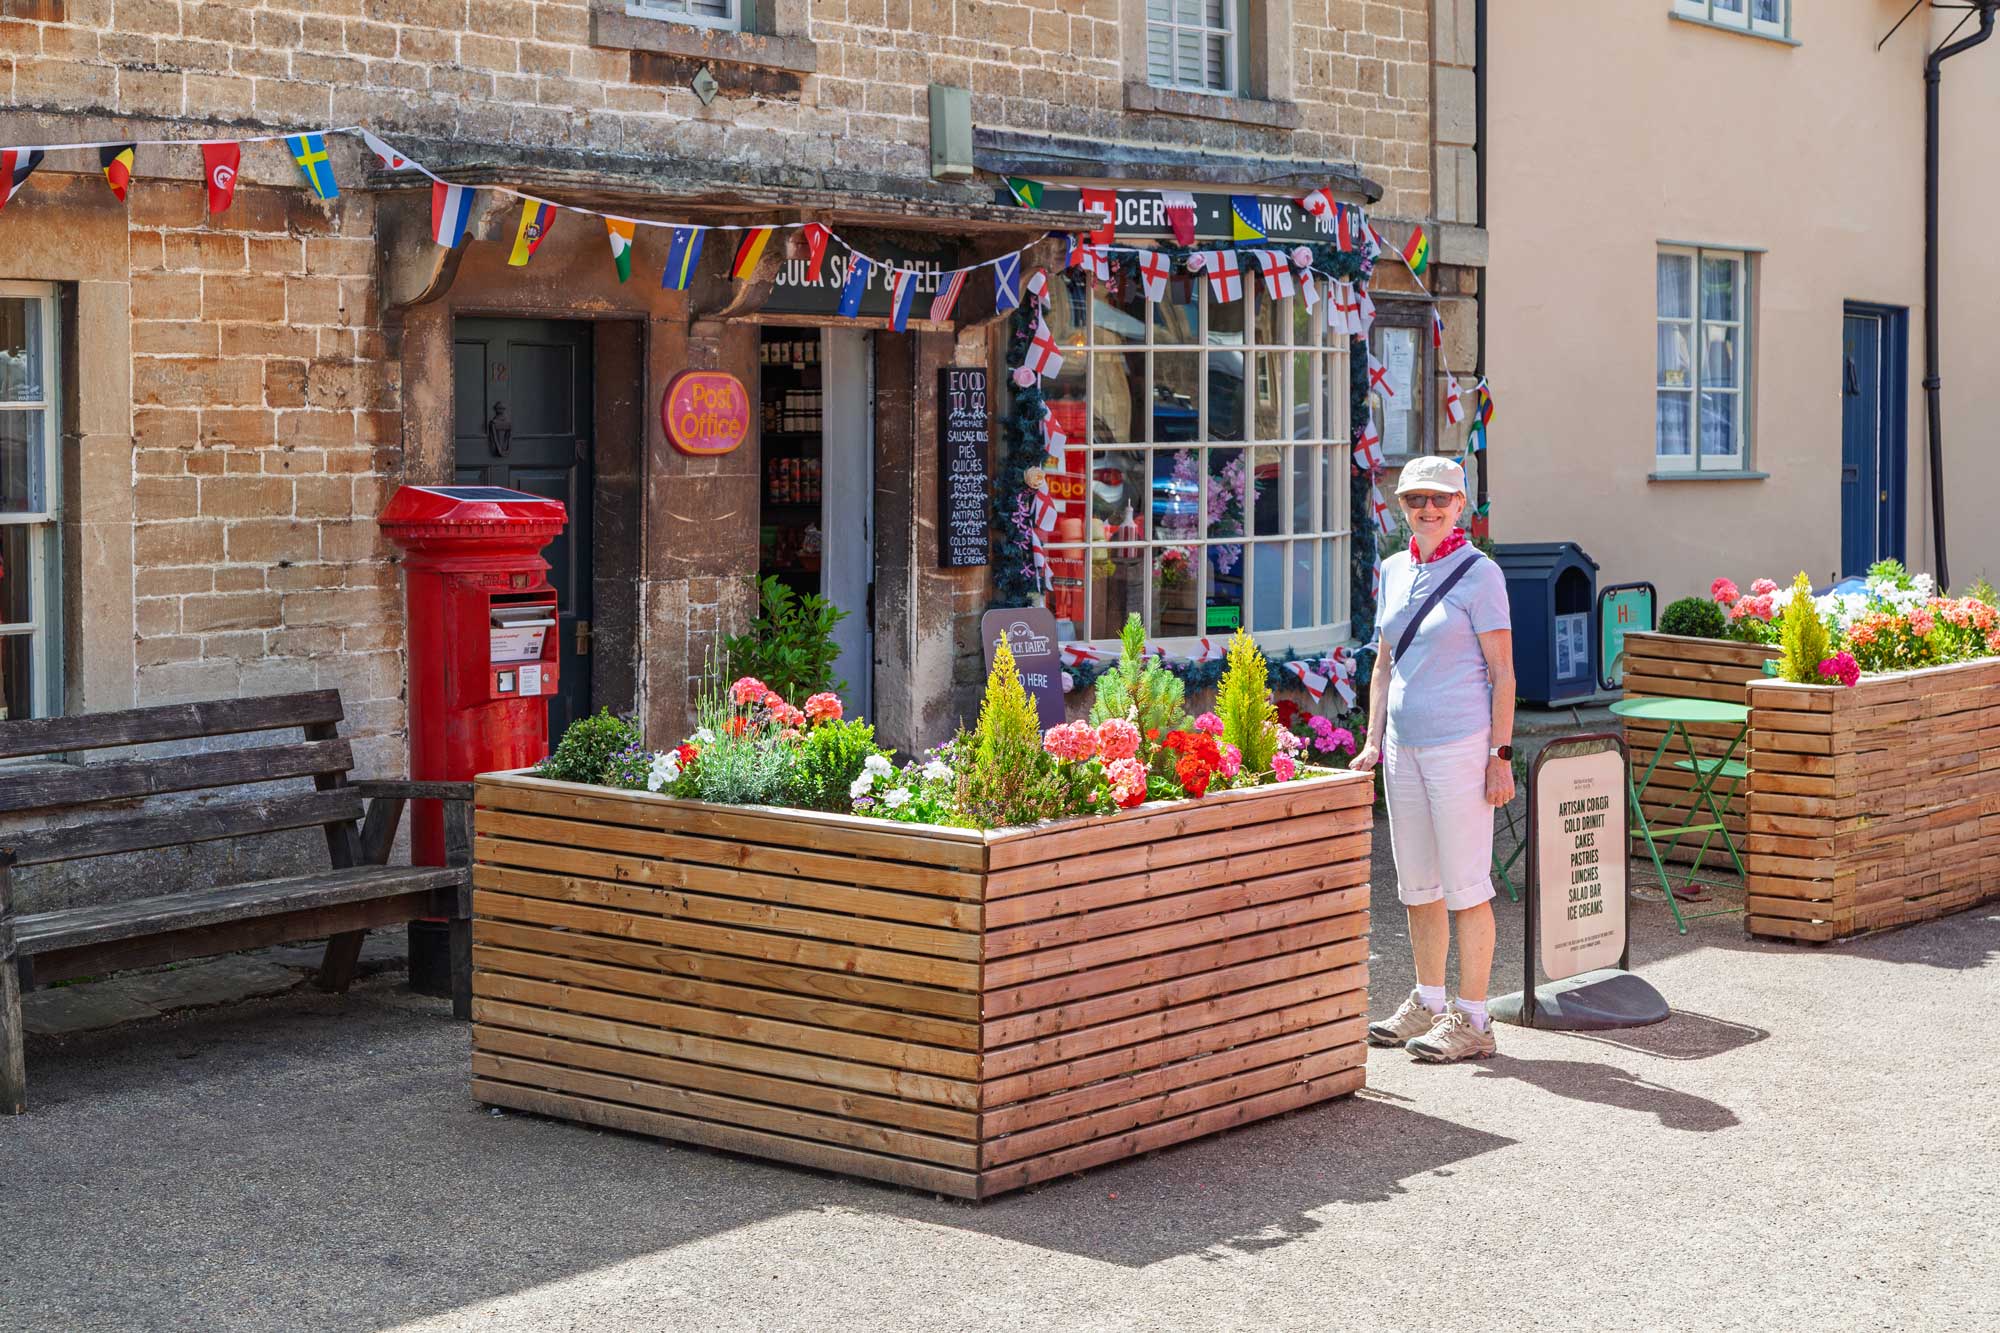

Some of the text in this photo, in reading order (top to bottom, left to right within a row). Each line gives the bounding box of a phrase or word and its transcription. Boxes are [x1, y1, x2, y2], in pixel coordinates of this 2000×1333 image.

[830, 254, 878, 290] SP
[884, 258, 895, 292] &
[903, 259, 940, 293] ELI
[950, 371, 986, 391] FOOD
[692, 383, 733, 409] Post
[950, 391, 986, 411] TO GO
[680, 412, 741, 439] Office
[952, 420, 983, 428] HOMEMADE
[947, 430, 975, 442] SAUSAGE
[959, 444, 976, 459] PIES
[952, 459, 982, 472] QUICHES
[953, 482, 982, 492] PASTIES
[955, 500, 981, 510] SALADS
[952, 509, 984, 520] ANTIPASTI
[956, 528, 980, 536] CAKES
[950, 536, 988, 546] COLD DRINKS
[953, 547, 983, 556] ALCOHOL
[952, 556, 987, 565] ICE CREAMS
[1024, 640, 1047, 653] DAIRY
[1027, 673, 1048, 688] HERE
[1559, 800, 1586, 817] ARTISAN
[1564, 817, 1580, 834] COLD
[1575, 832, 1595, 849] CAKES
[1570, 849, 1599, 867] PASTRIES
[1571, 866, 1599, 885] LUNCHES
[1568, 883, 1602, 903] SALAD BAR
[1567, 900, 1603, 921] ICE CREAMS
